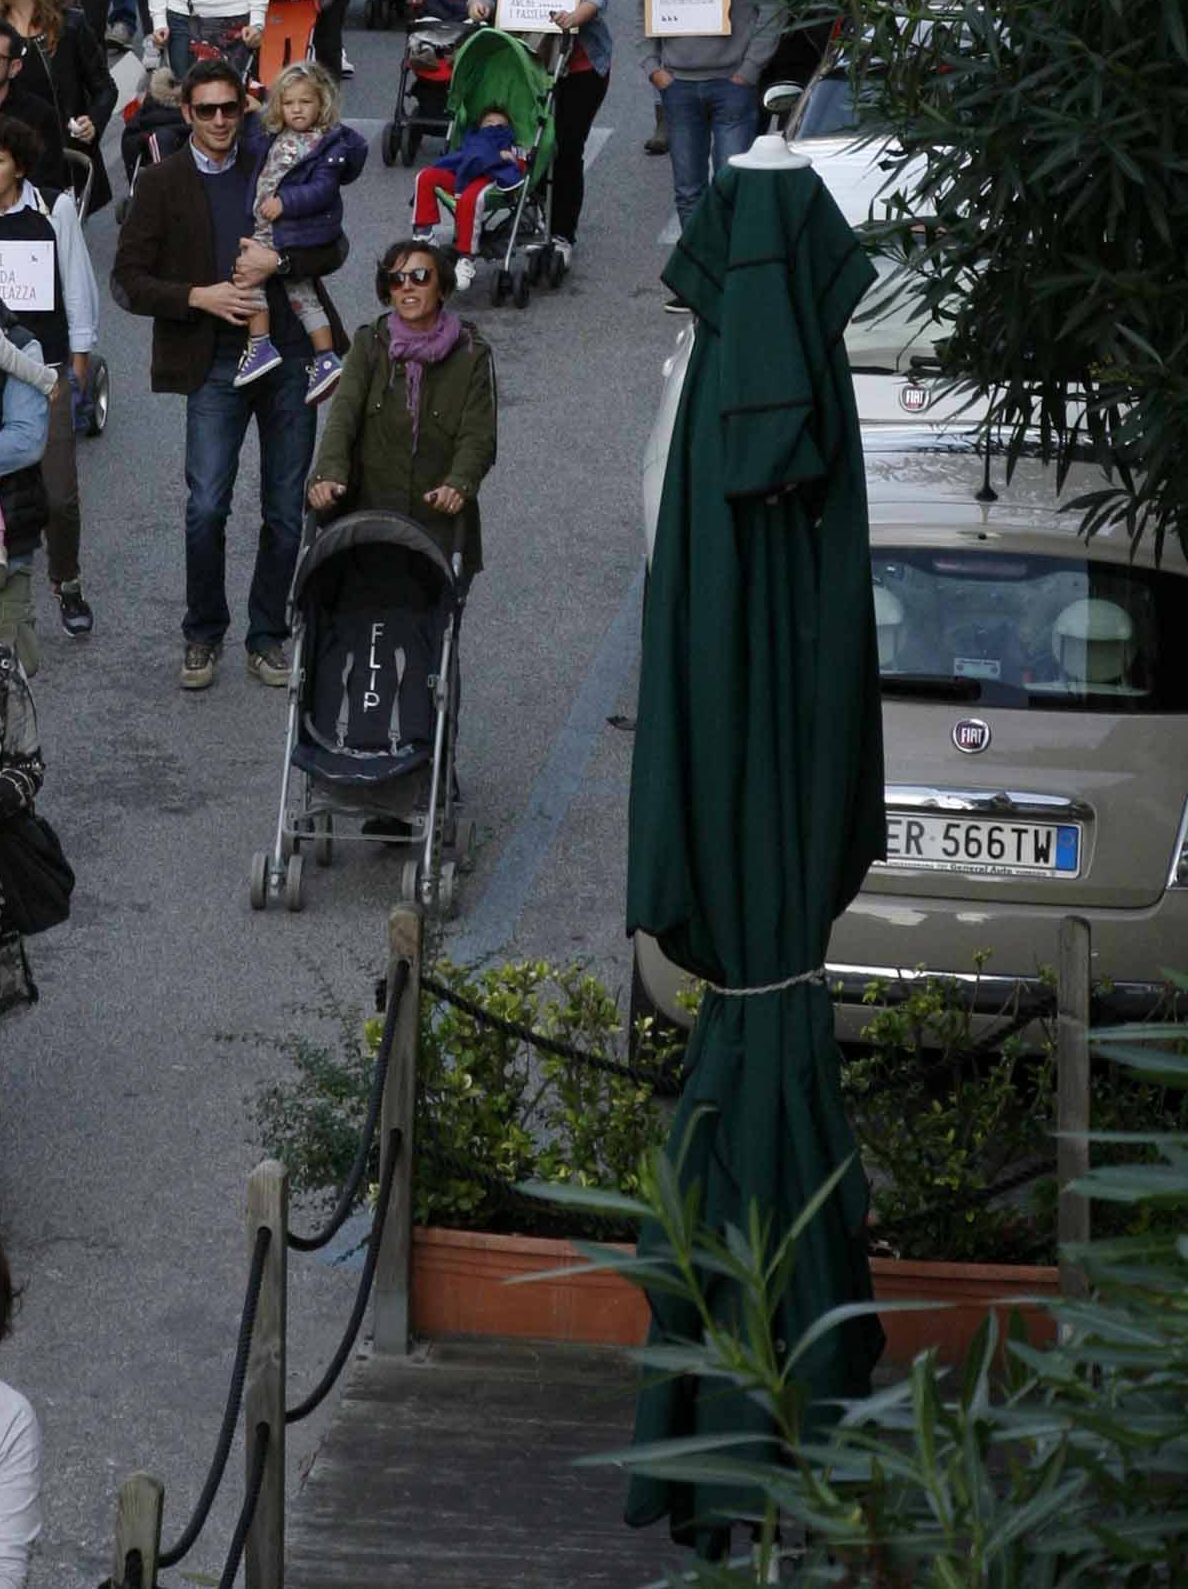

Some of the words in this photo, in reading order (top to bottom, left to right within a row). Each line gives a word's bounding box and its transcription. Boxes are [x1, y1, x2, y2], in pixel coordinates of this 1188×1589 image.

[906, 390, 924, 404] FIAT
[362, 621, 386, 714] FLIP
[960, 726, 984, 744] FIAT
[941, 822, 1053, 865] 566TW
